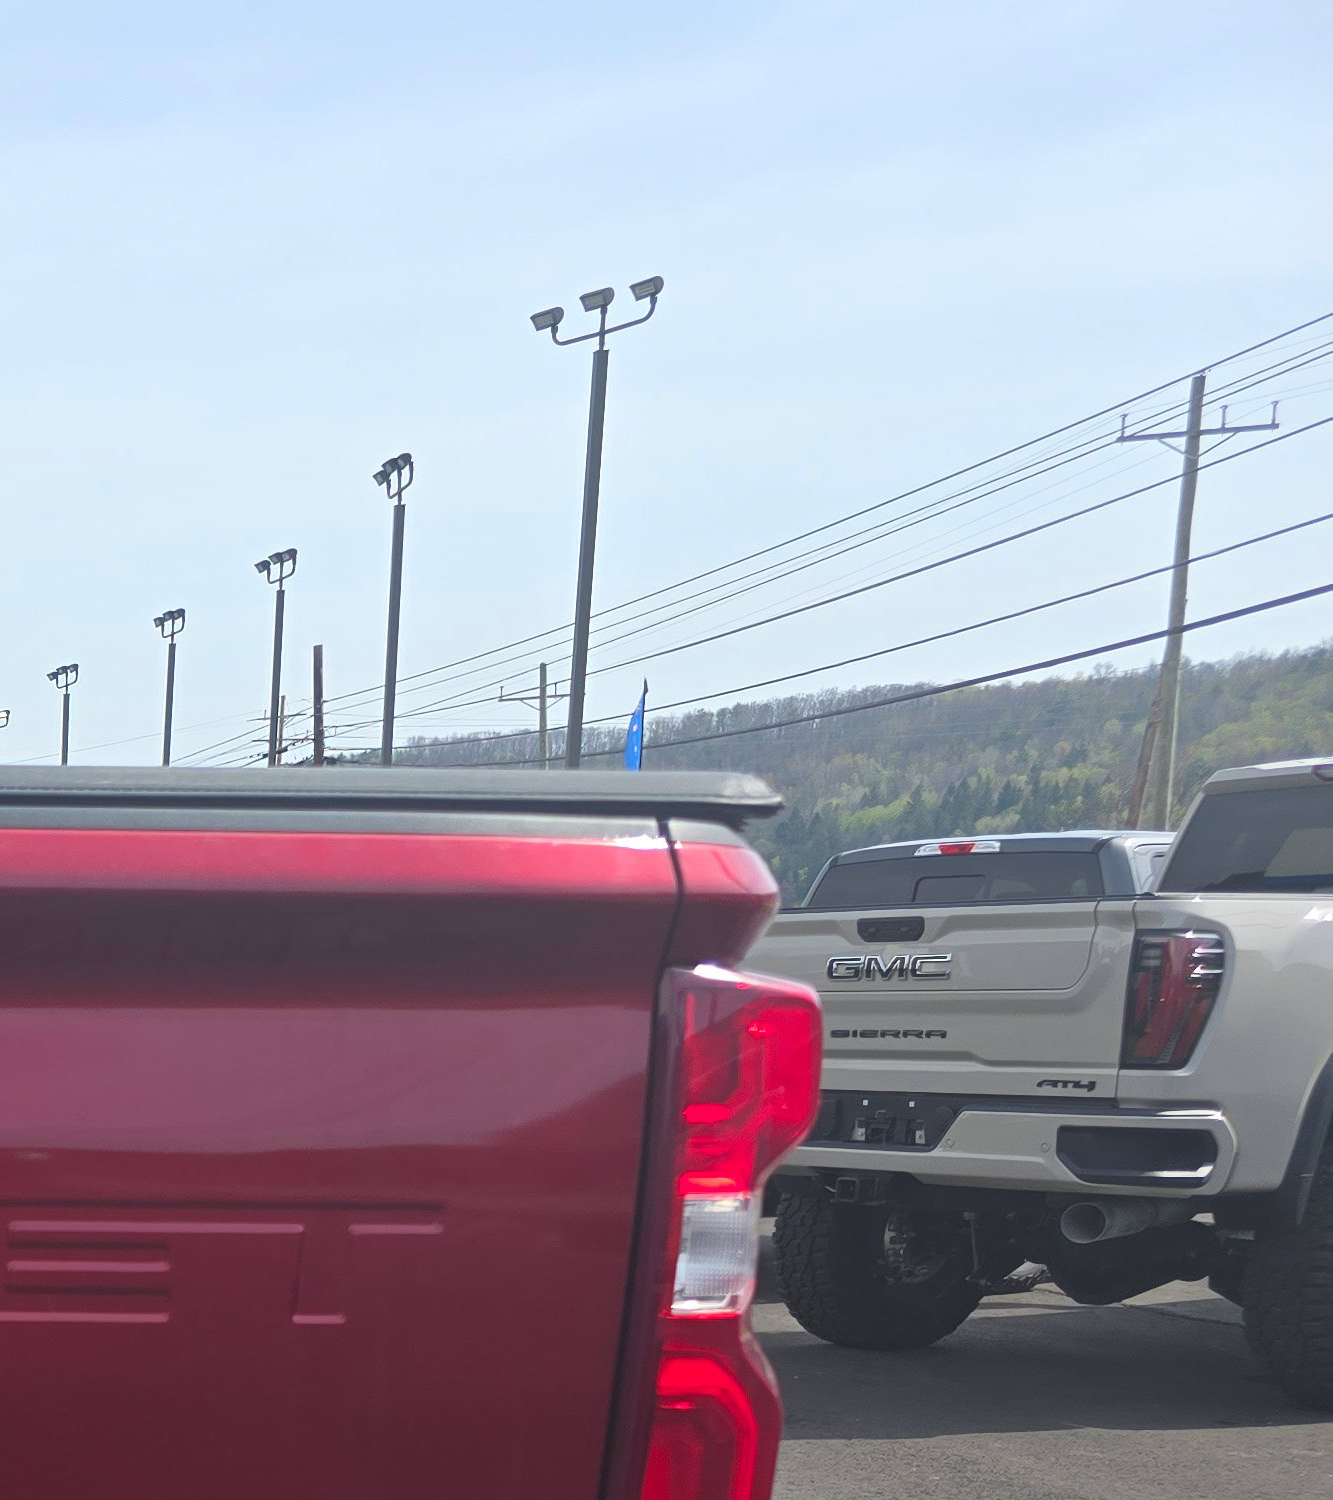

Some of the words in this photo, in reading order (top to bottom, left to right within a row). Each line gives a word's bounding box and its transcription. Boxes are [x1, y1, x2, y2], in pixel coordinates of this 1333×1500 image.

[827, 954, 953, 981] GMC
[830, 1029, 947, 1039] SIERRA
[1036, 1079, 1097, 1093] AT4
